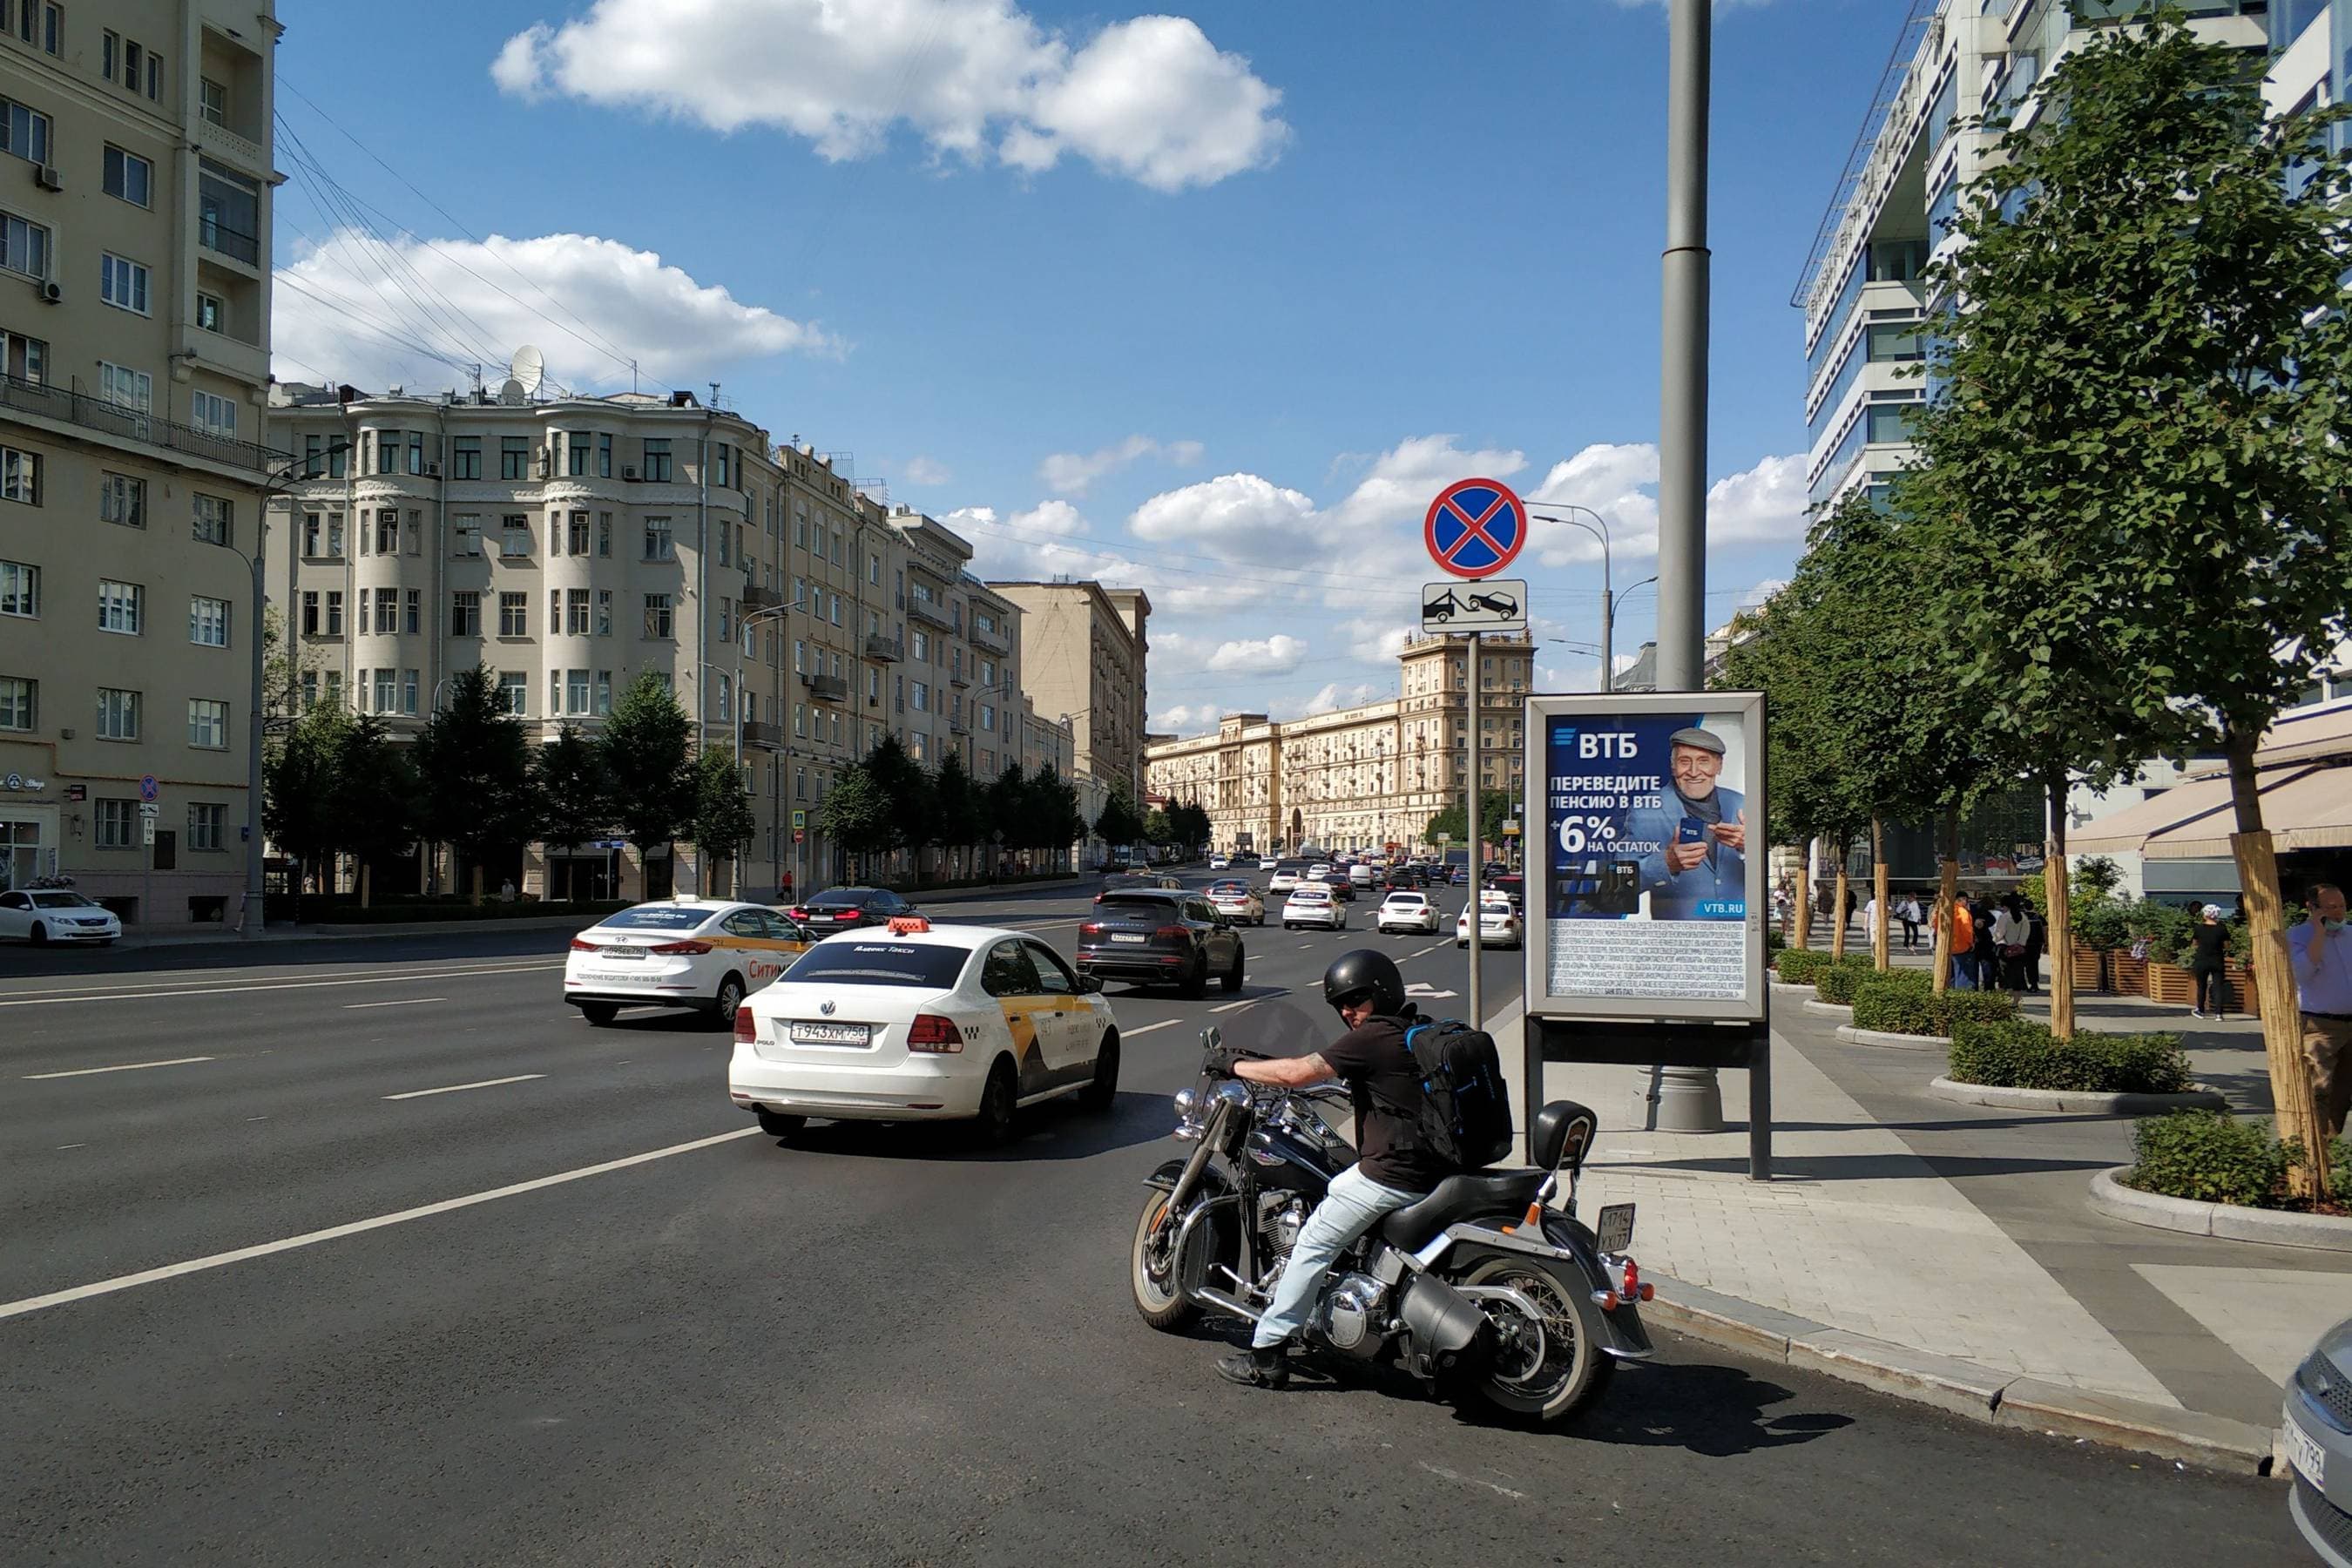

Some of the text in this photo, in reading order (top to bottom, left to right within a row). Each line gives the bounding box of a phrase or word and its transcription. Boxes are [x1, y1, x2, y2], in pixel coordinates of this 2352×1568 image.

[1579, 733, 1638, 759] ВТБ
[1551, 775, 1660, 794] ПЕРЕВЕДИТЕ
[1551, 795, 1662, 808] ПЕНСИЮ В ВТБ
[1587, 841, 1660, 853] НА ОСТАТОК
[1616, 866, 1634, 875] ВТБ
[1704, 902, 1743, 914] VTB.RU
